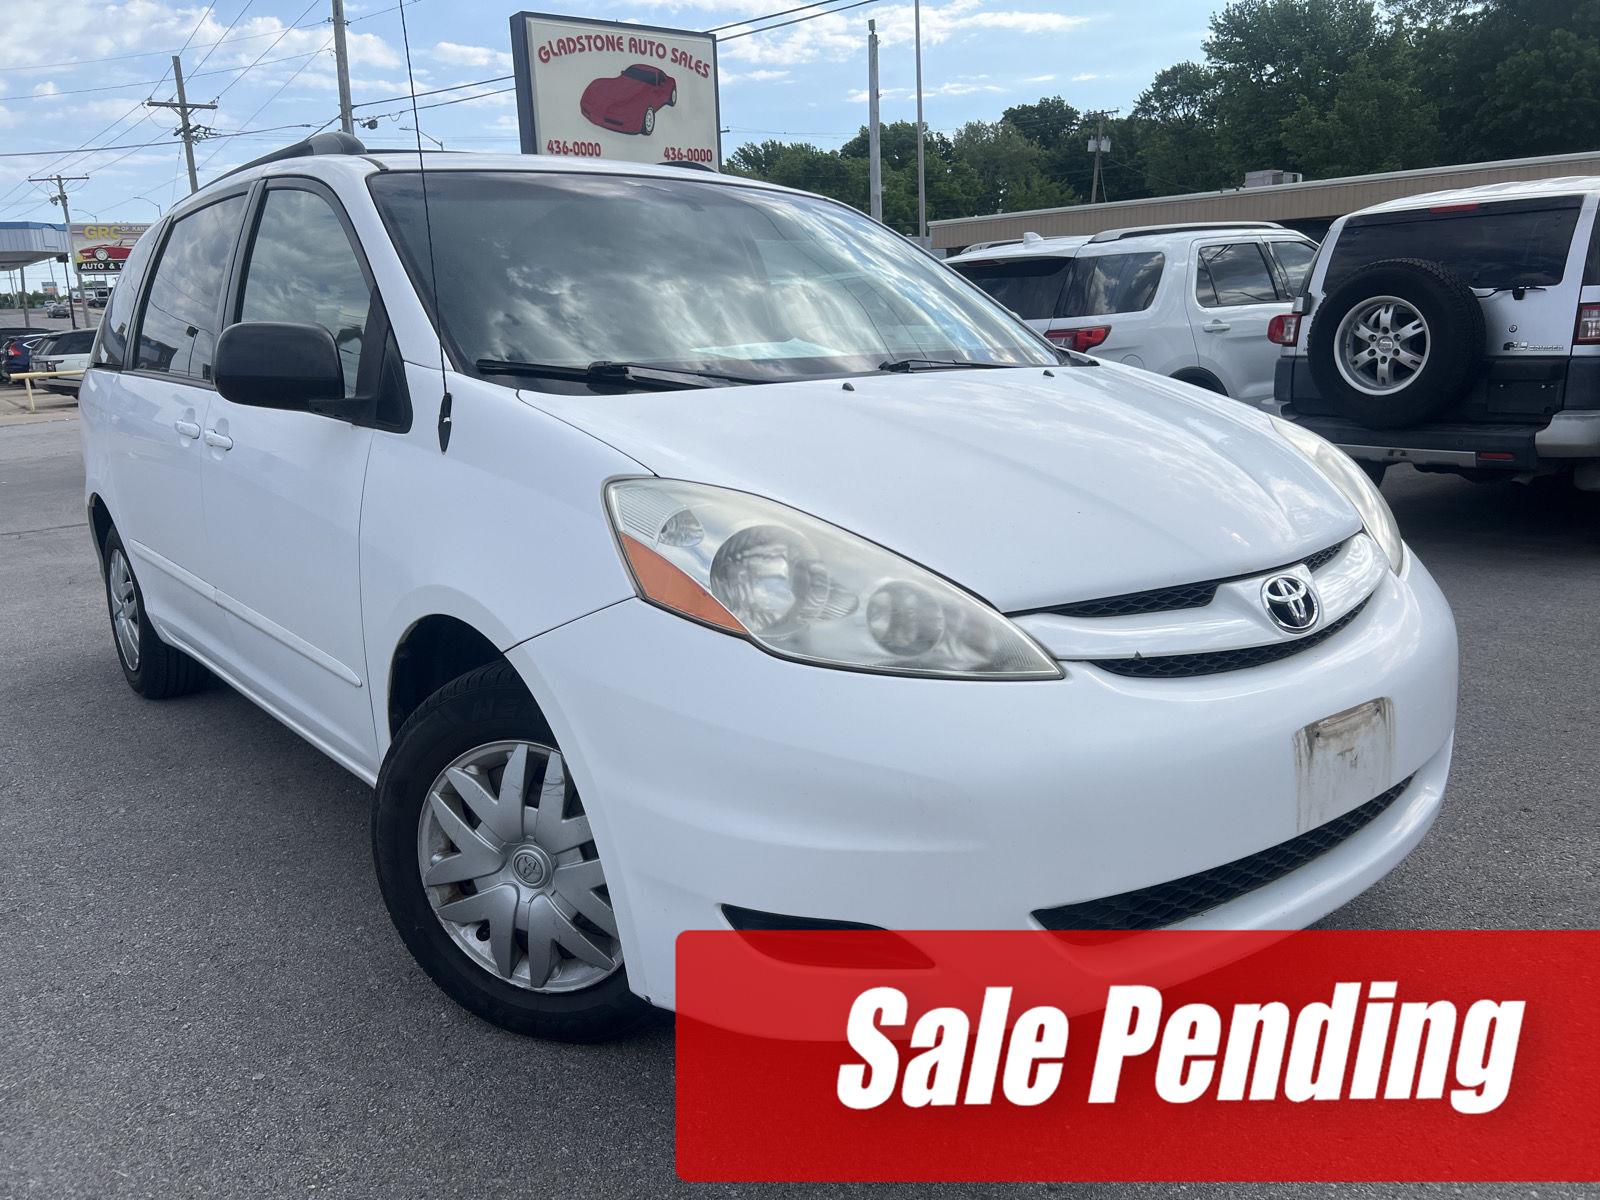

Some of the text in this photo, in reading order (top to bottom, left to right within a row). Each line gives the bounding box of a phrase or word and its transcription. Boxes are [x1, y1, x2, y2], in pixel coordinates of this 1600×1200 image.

[538, 34, 711, 79] GLADSTONE AUTO SALES
[547, 139, 601, 157] 436-0000
[663, 146, 712, 162] 436-0000
[83, 225, 119, 240] GRC
